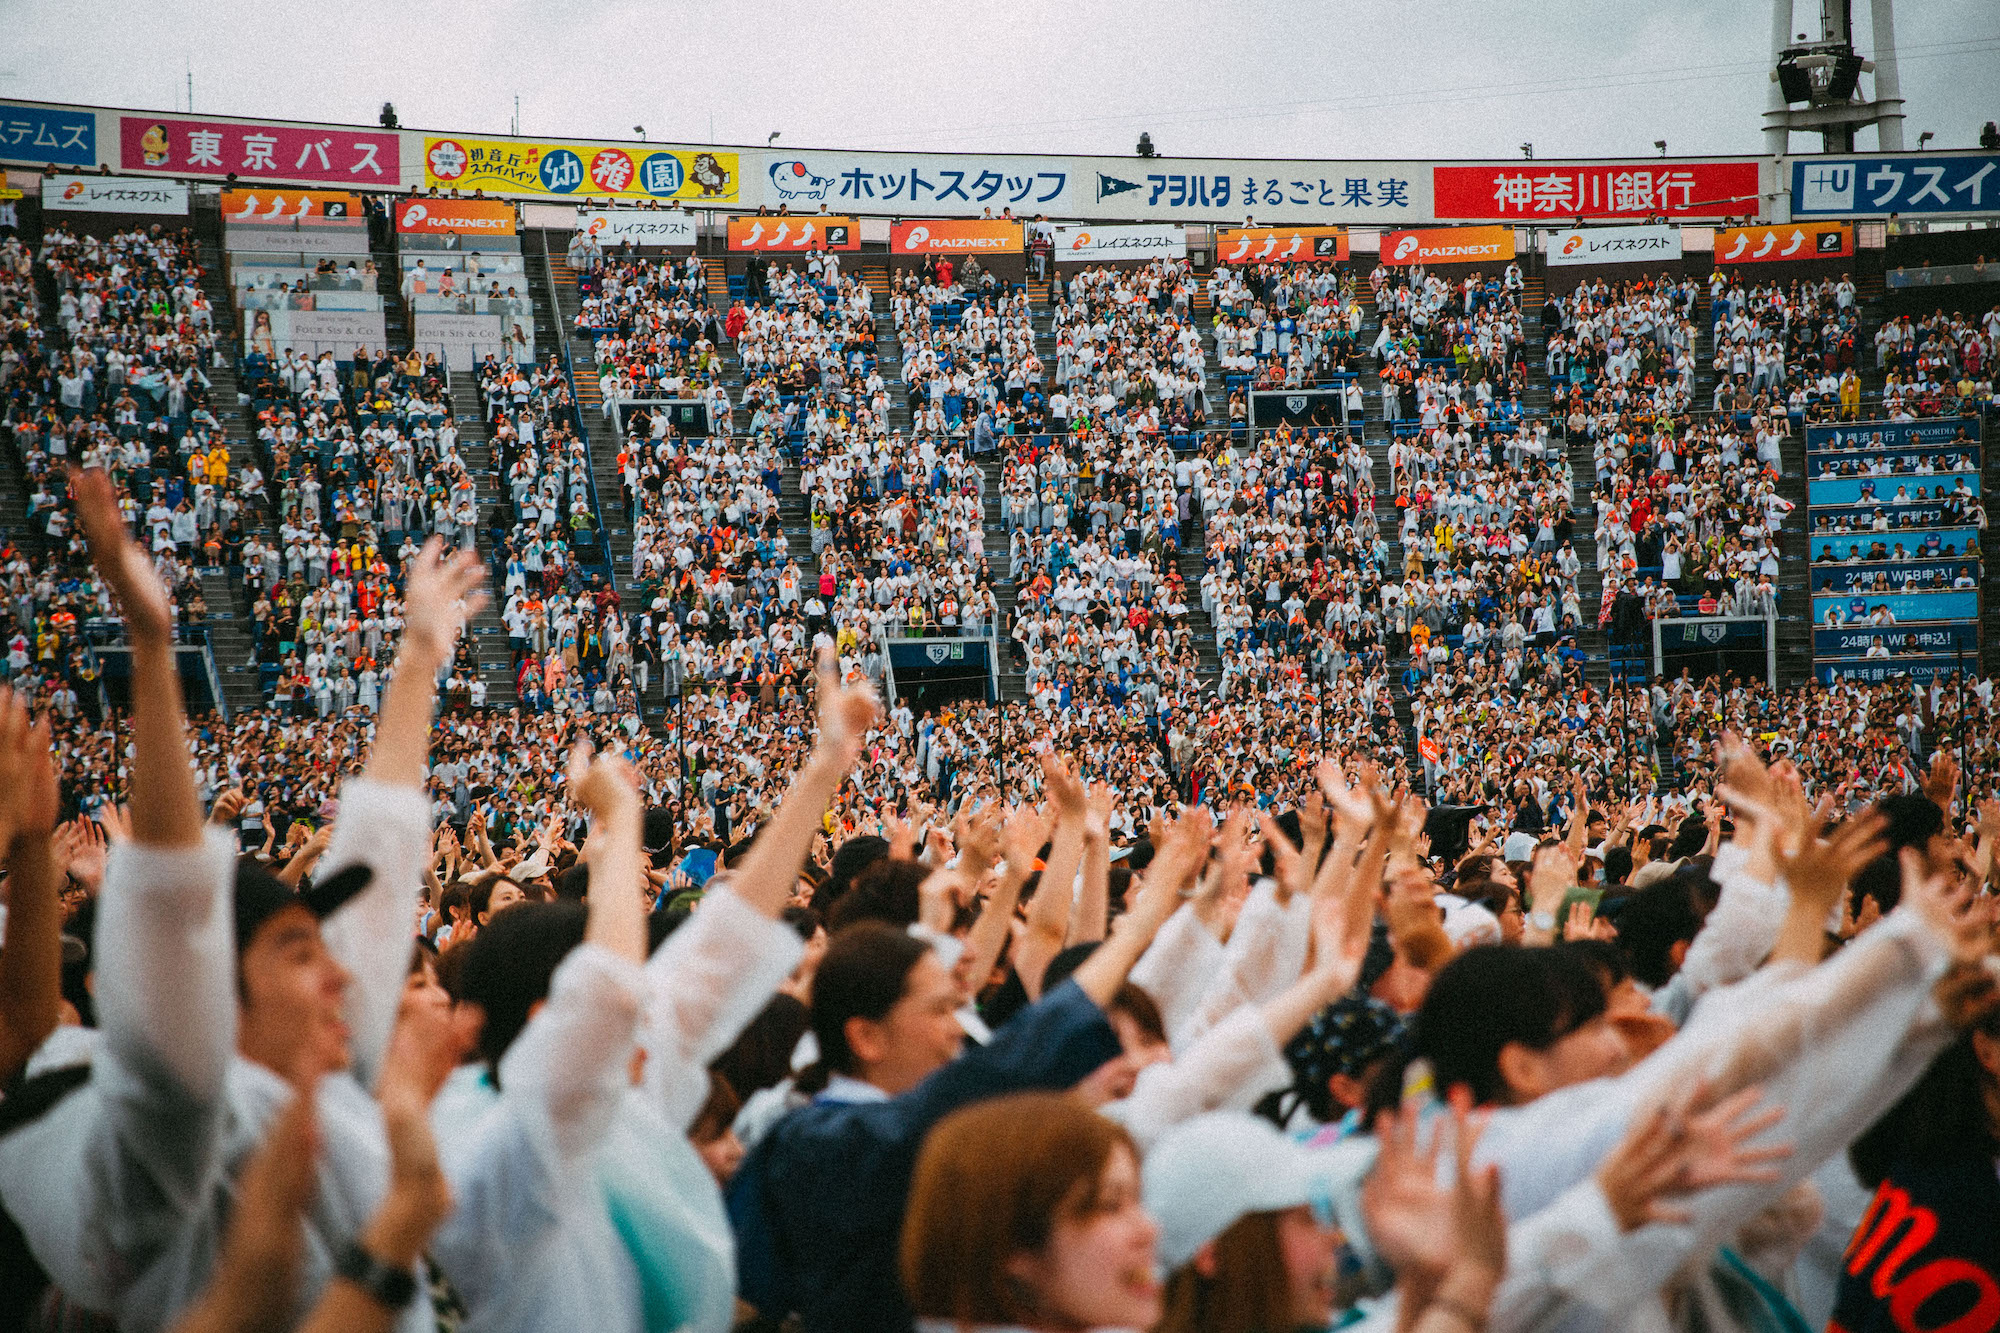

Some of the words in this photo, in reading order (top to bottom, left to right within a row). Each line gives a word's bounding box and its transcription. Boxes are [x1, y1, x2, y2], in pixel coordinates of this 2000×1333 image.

[0, 121, 88, 149] テムズ
[186, 129, 383, 176] 東京バス
[470, 148, 521, 167] 初音丘
[470, 162, 537, 184] スカイハイツ
[545, 152, 679, 192] 幼稚園
[840, 168, 1066, 203] ホットスタッフ
[1147, 175, 1230, 207] アヲハタ
[1241, 177, 1409, 208] まるごと果実
[1493, 171, 1695, 212] 神奈川銀行
[1866, 161, 2000, 207] ウスイ
[91, 188, 172, 203] レイズネクスト
[427, 217, 508, 228] RAIZNEXT
[613, 223, 689, 235] レイズネクスト
[929, 237, 1009, 248] RAIZNEXT
[1098, 236, 1173, 249] レイズネクスト
[1590, 237, 1670, 252] レイズネクスト
[1419, 244, 1500, 257] RAIZNEXT
[1291, 400, 1303, 409] 20
[1846, 430, 1896, 444] 横浜行
[1708, 628, 1719, 638] 21
[932, 648, 944, 658] 19
